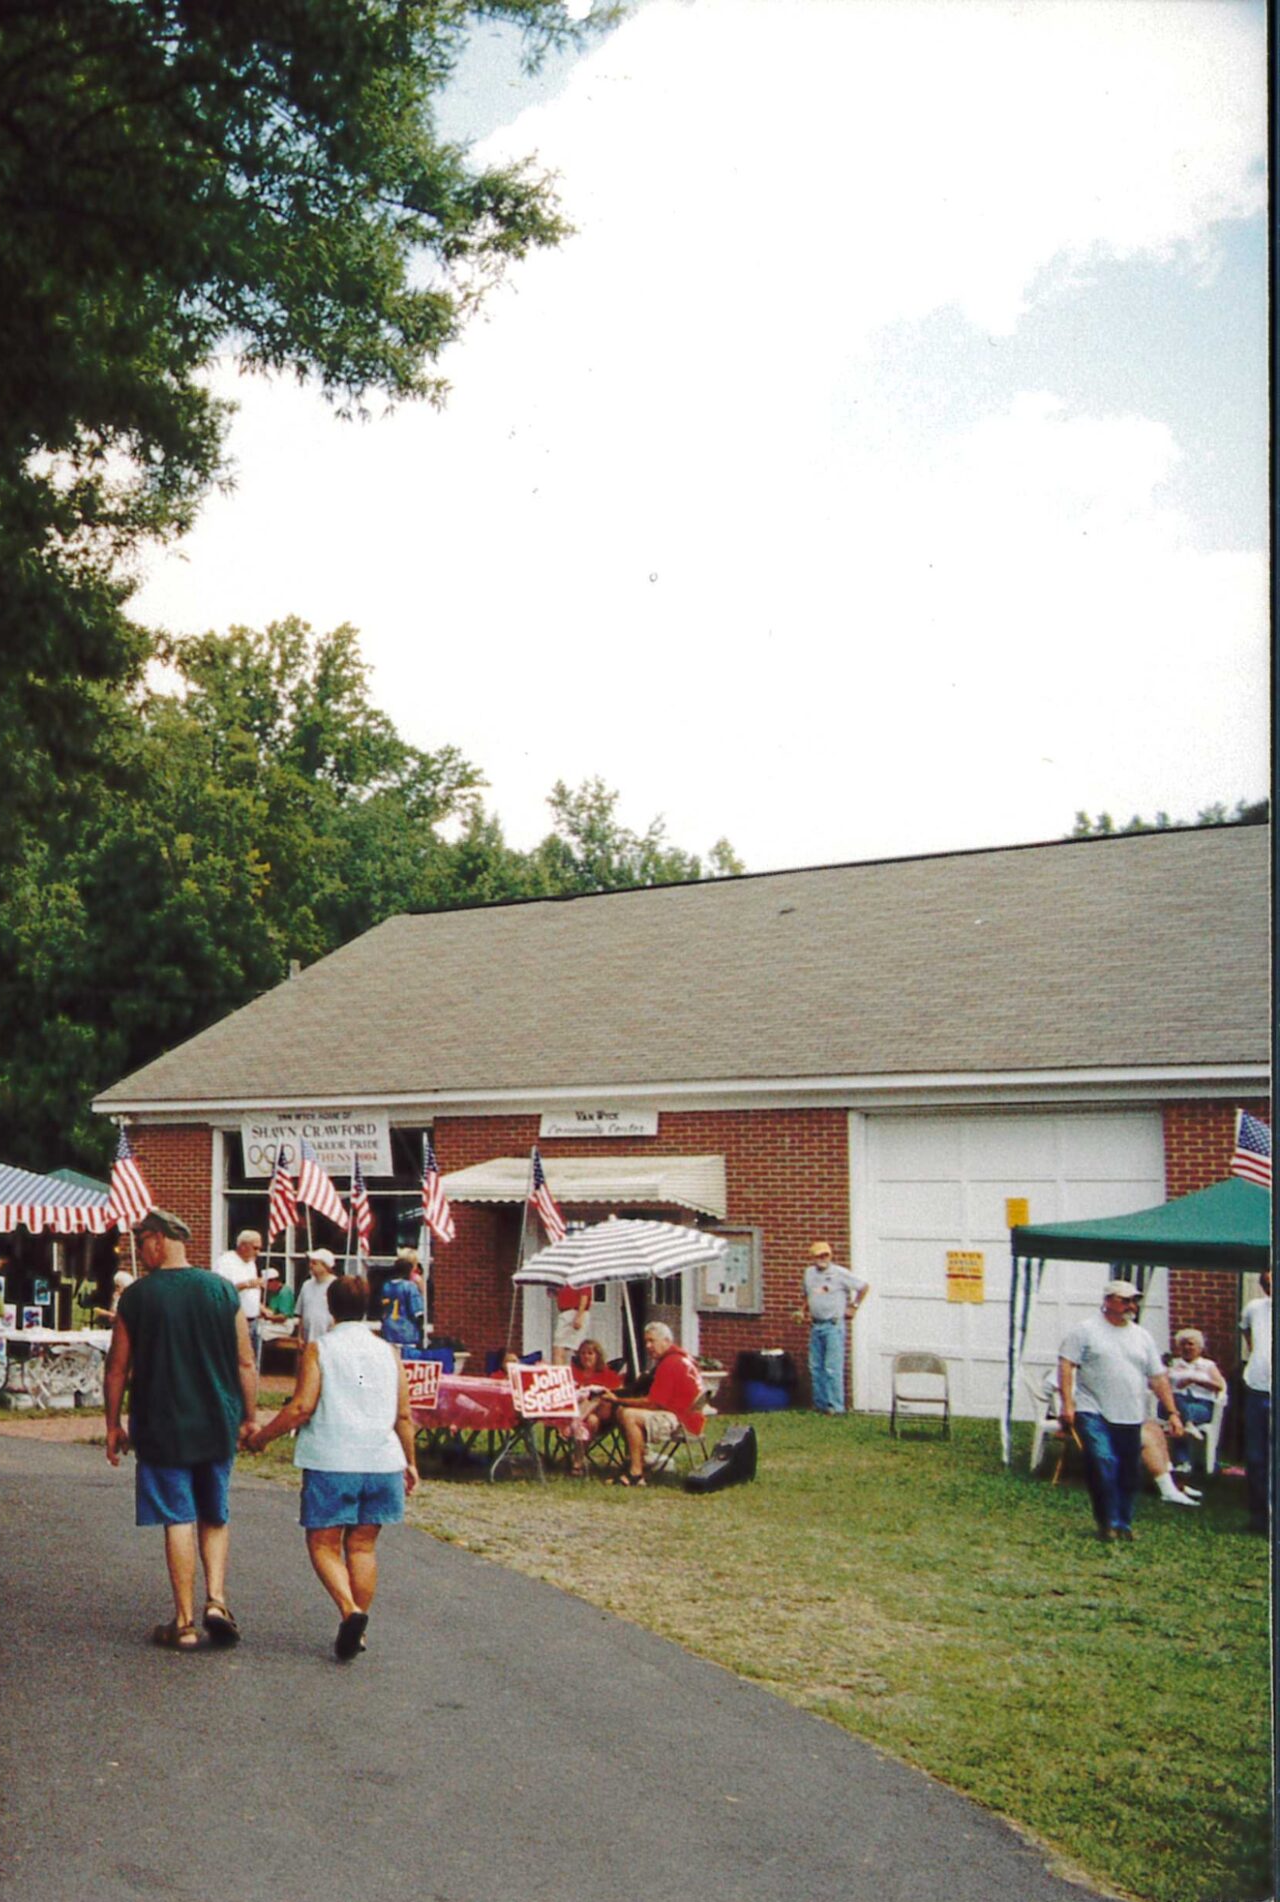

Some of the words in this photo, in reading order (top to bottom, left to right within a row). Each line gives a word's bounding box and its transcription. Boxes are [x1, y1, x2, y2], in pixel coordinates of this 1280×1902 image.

[302, 1123, 377, 1138] CRAWFORD
[529, 1366, 571, 1393] John
[523, 1381, 577, 1411] Spratt
